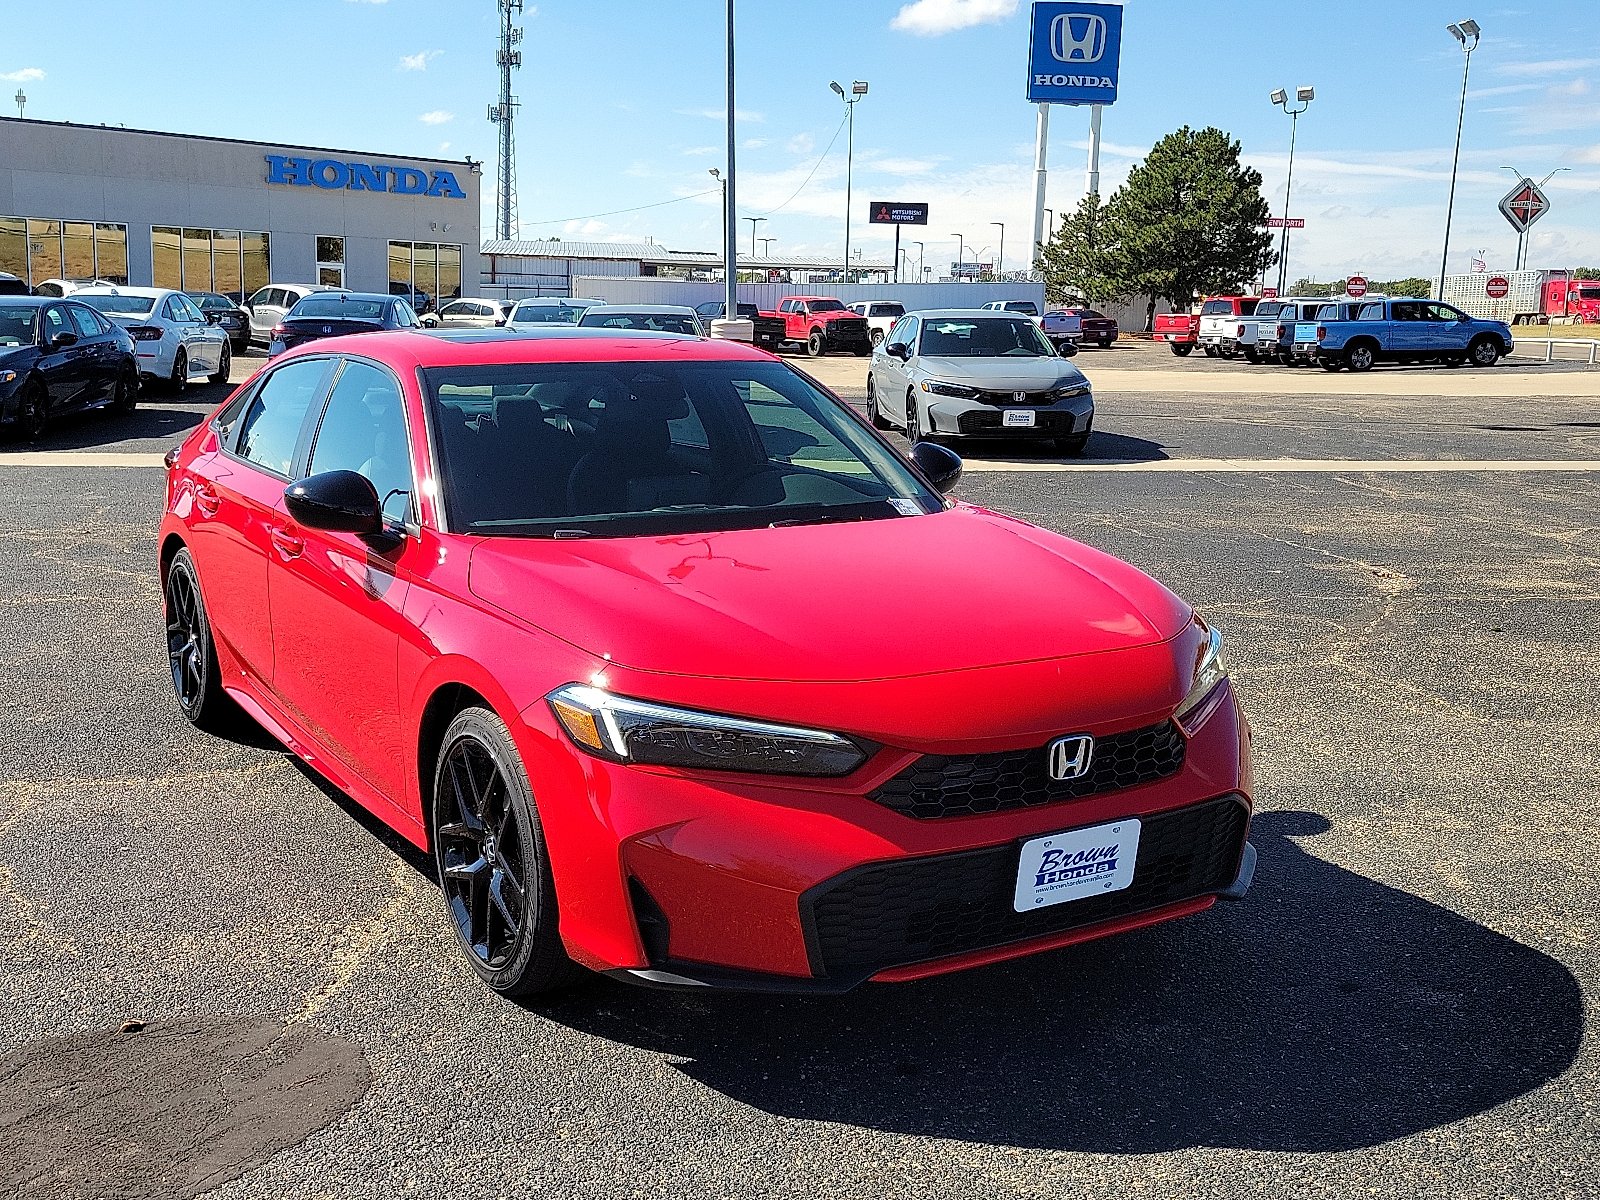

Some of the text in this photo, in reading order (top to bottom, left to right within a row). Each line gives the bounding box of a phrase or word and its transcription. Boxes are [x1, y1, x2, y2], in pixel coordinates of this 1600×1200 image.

[1034, 74, 1114, 89] HONDA
[265, 154, 467, 199] HONDA
[1037, 843, 1119, 874] Brown
[1043, 863, 1109, 884] Honda
